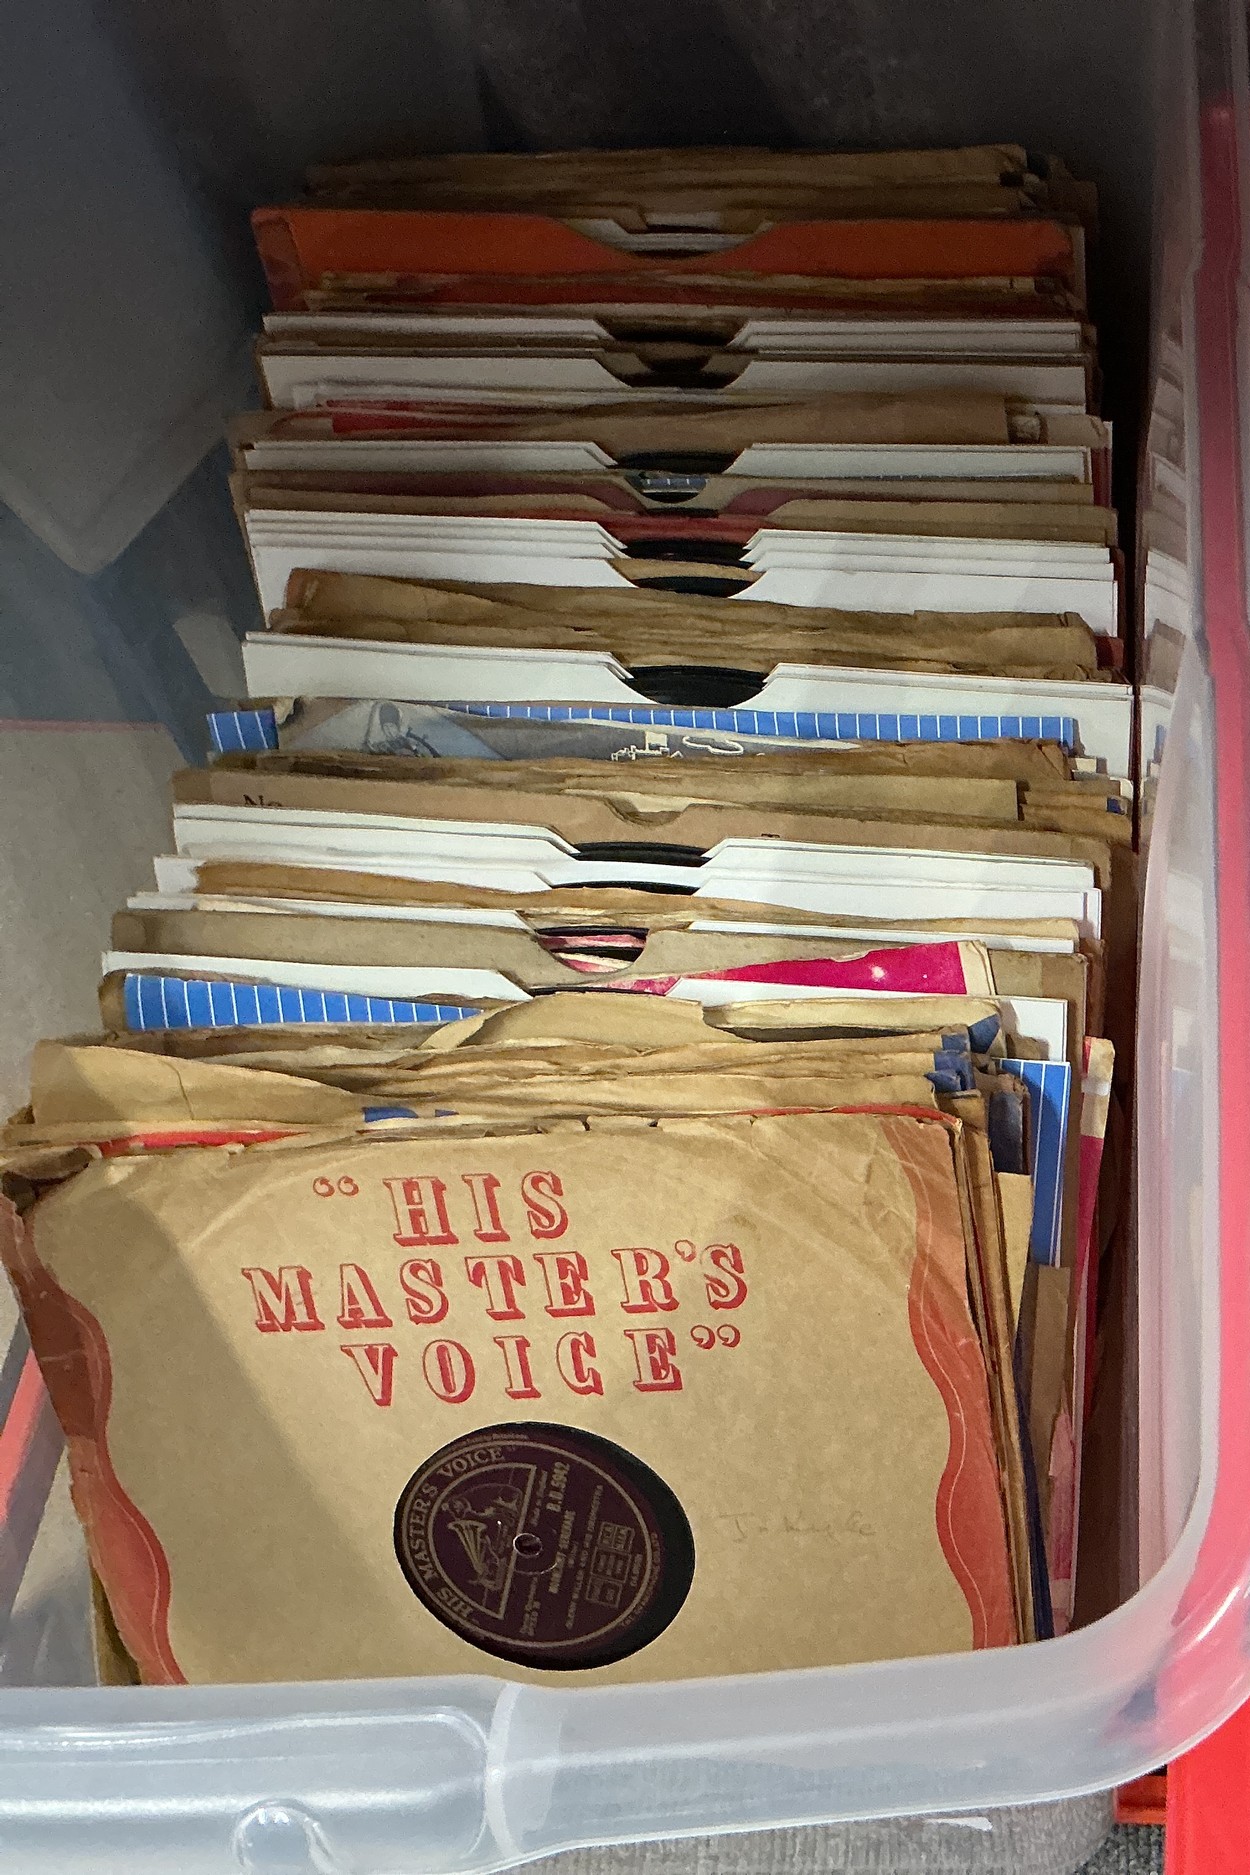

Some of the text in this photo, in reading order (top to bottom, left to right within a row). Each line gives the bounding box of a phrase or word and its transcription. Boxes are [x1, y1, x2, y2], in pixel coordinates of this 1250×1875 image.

[312, 1170, 571, 1247] “HIS
[241, 1239, 749, 1333] MASTER'S
[340, 1323, 742, 1407] VOICE”
